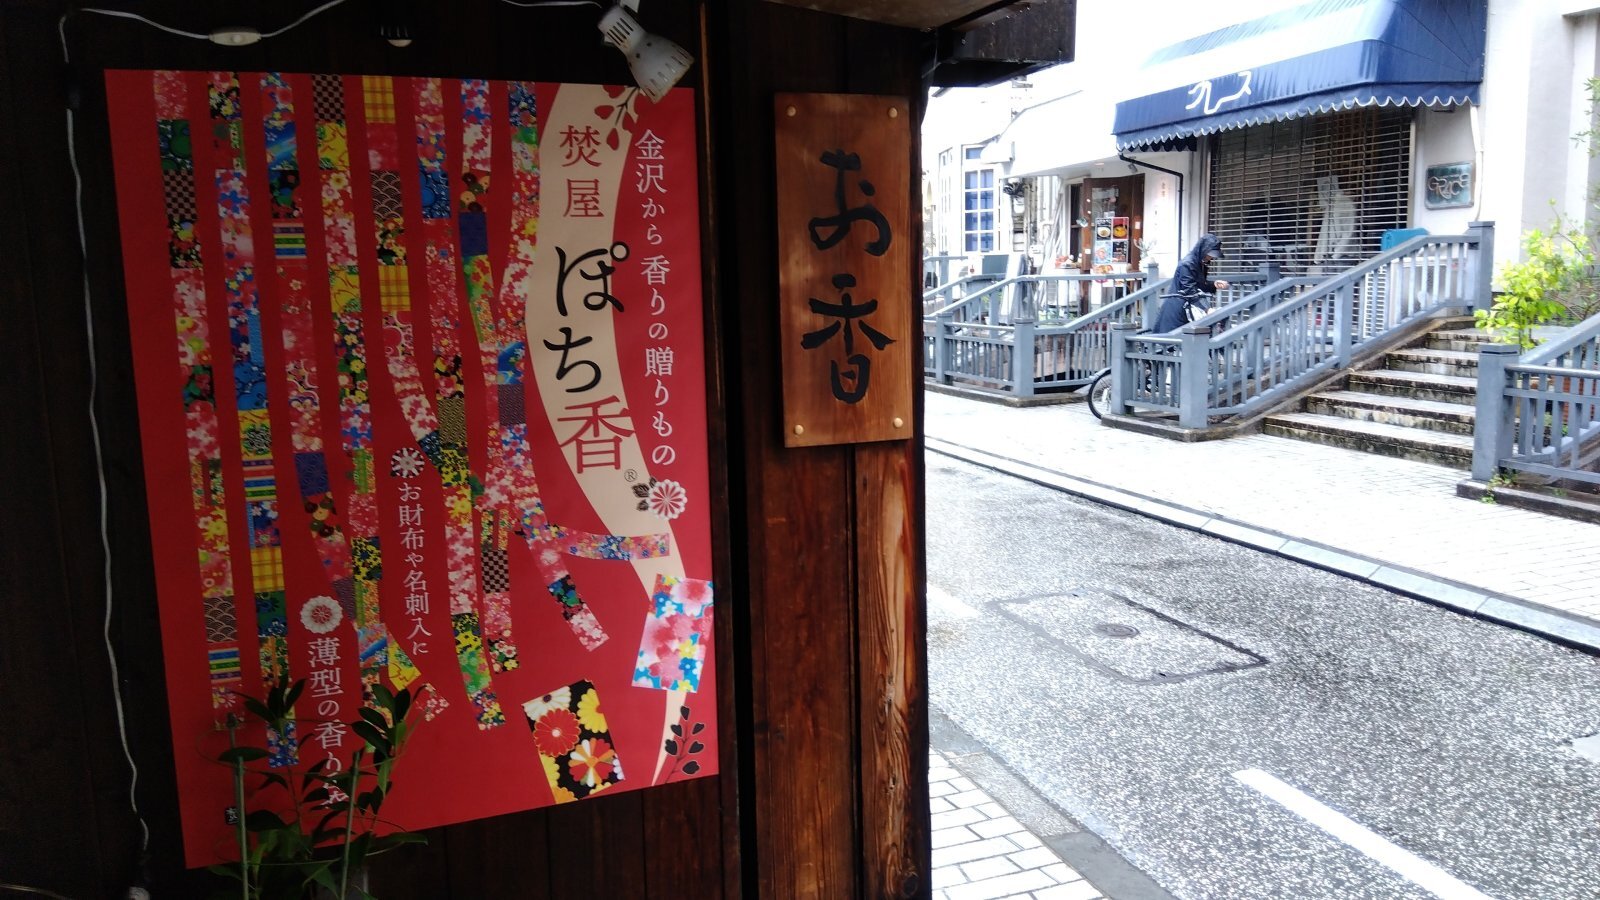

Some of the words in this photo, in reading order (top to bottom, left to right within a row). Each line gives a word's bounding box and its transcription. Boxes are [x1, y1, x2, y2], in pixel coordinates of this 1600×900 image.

[635, 129, 676, 466] 金沢から香りの贈りもの
[801, 148, 897, 405] お香
[399, 482, 431, 656] お財布や名刺入に
